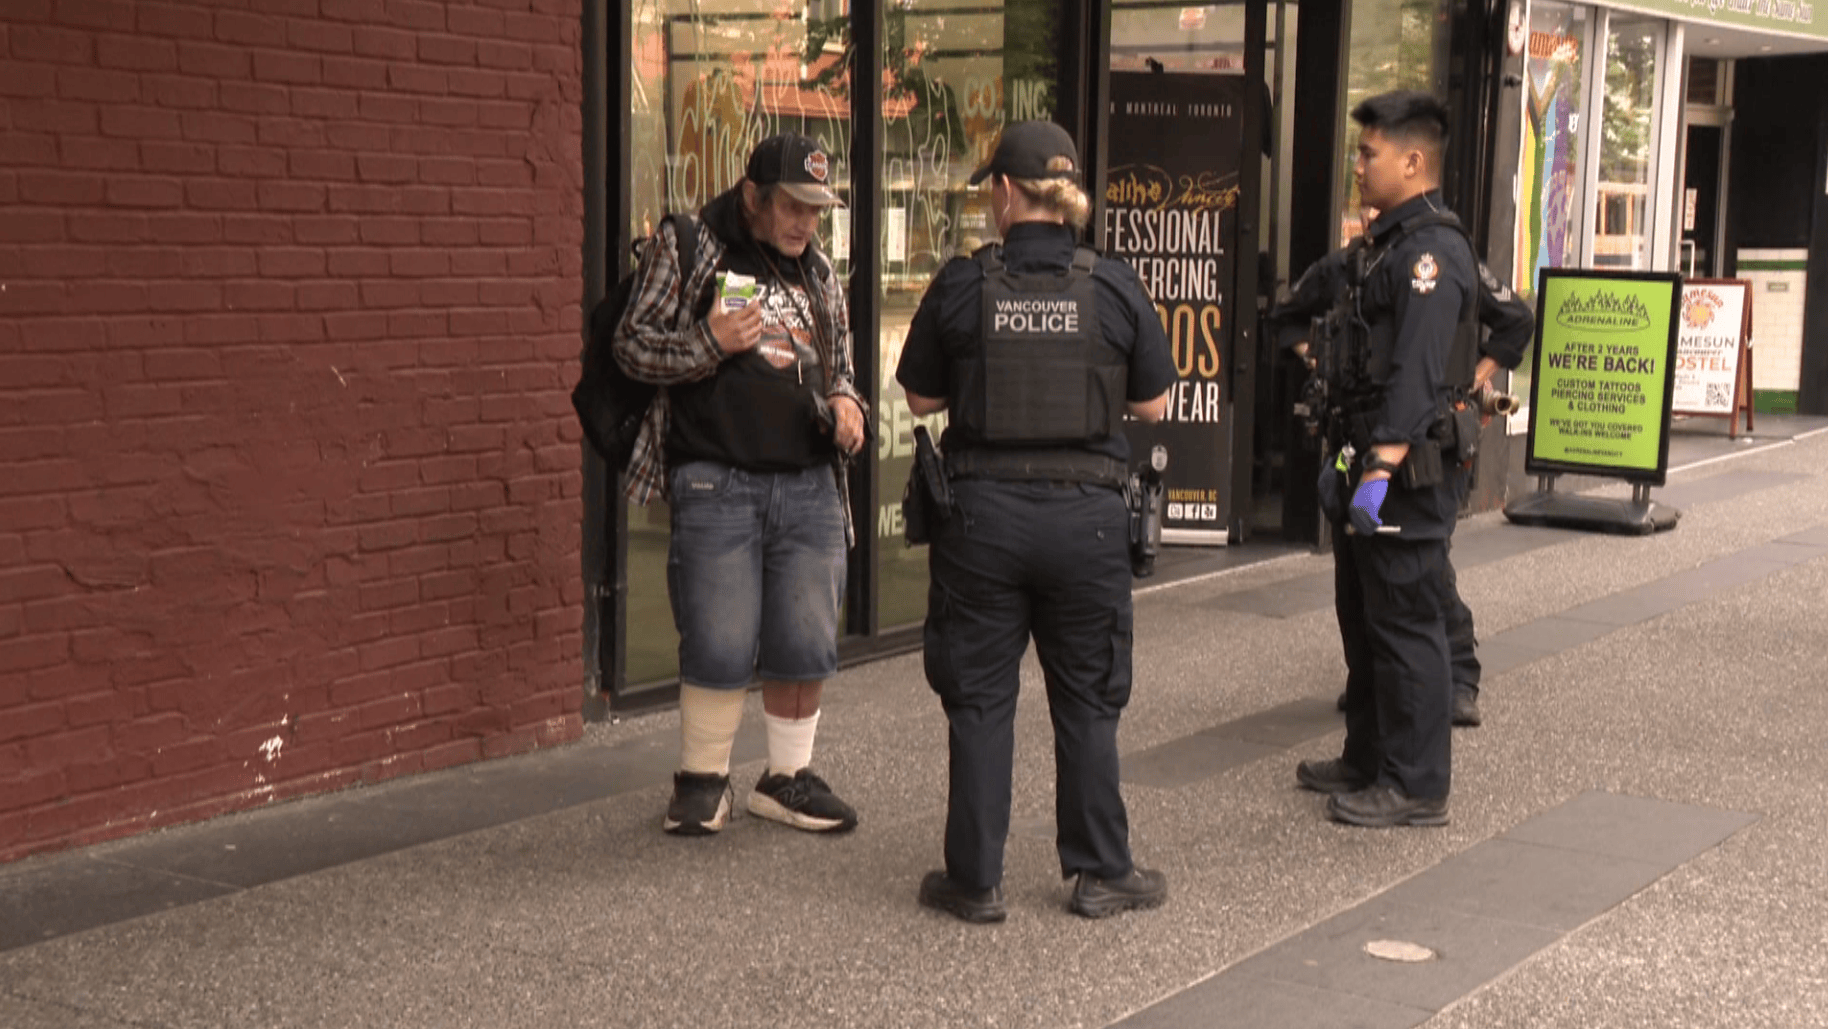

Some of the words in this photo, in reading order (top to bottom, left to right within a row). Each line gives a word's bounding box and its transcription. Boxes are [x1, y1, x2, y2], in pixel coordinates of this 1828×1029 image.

[1126, 101, 1177, 116] MONTREAL
[1187, 103, 1232, 117] TORONTO
[1105, 207, 1224, 254] FESSIONAL
[1123, 256, 1222, 304] ERCING,
[995, 300, 1077, 313] VANCOUVER
[994, 313, 1079, 332] POLICE
[1567, 314, 1639, 326] ADRENALINE
[1564, 341, 1595, 354] AFTER
[1606, 343, 1639, 356] YEARS
[1680, 335, 1735, 349] MESUN
[1549, 352, 1598, 371] WE'RE
[1603, 356, 1655, 375] BACK!
[1676, 356, 1732, 371] OSTEL
[1557, 378, 1596, 389] CUSTOM
[1599, 381, 1641, 393] TATTOOS
[1551, 388, 1594, 401] PIERCING
[1597, 392, 1646, 404] SERVICES
[1577, 402, 1626, 414] CLOTHING
